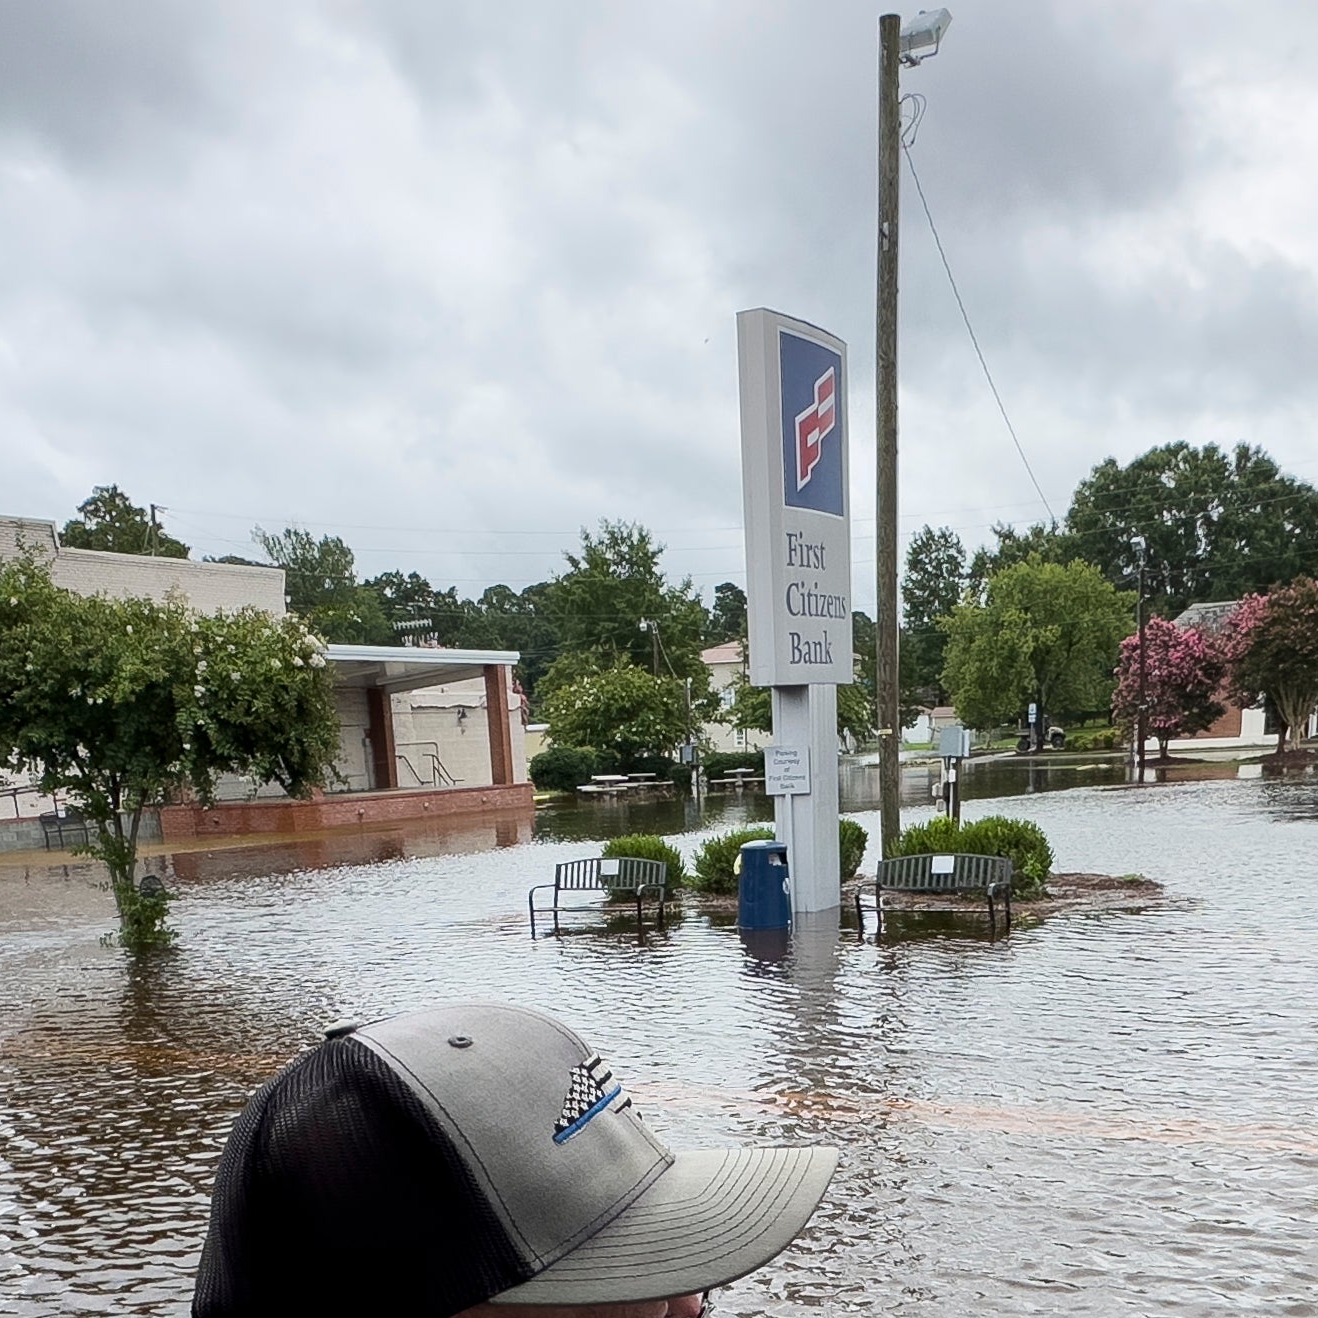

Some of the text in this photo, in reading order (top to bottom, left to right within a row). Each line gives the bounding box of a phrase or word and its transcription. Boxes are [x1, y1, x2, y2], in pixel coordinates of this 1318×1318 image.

[786, 531, 826, 571] First
[786, 581, 846, 620] Citizens
[789, 630, 833, 665] Bank
